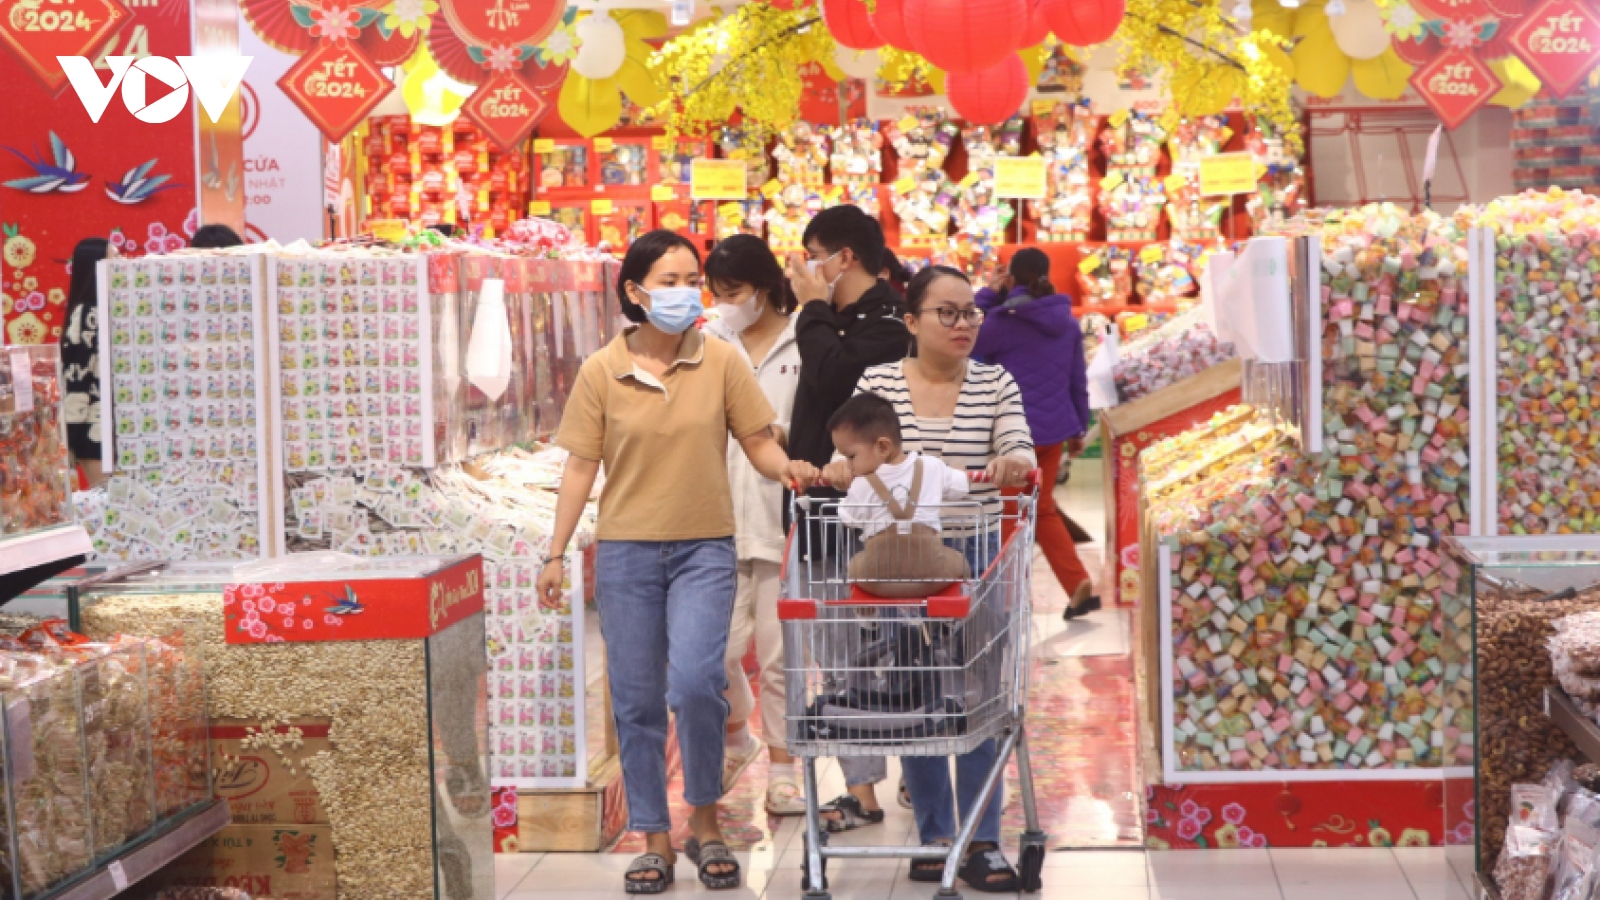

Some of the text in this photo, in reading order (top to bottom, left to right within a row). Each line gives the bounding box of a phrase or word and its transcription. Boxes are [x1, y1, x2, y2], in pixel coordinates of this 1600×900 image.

[24, 9, 91, 31] 2024
[1540, 37, 1591, 53] 2024
[316, 81, 365, 98] 2024
[1438, 81, 1478, 96] 2024
[490, 103, 529, 117] 2024
